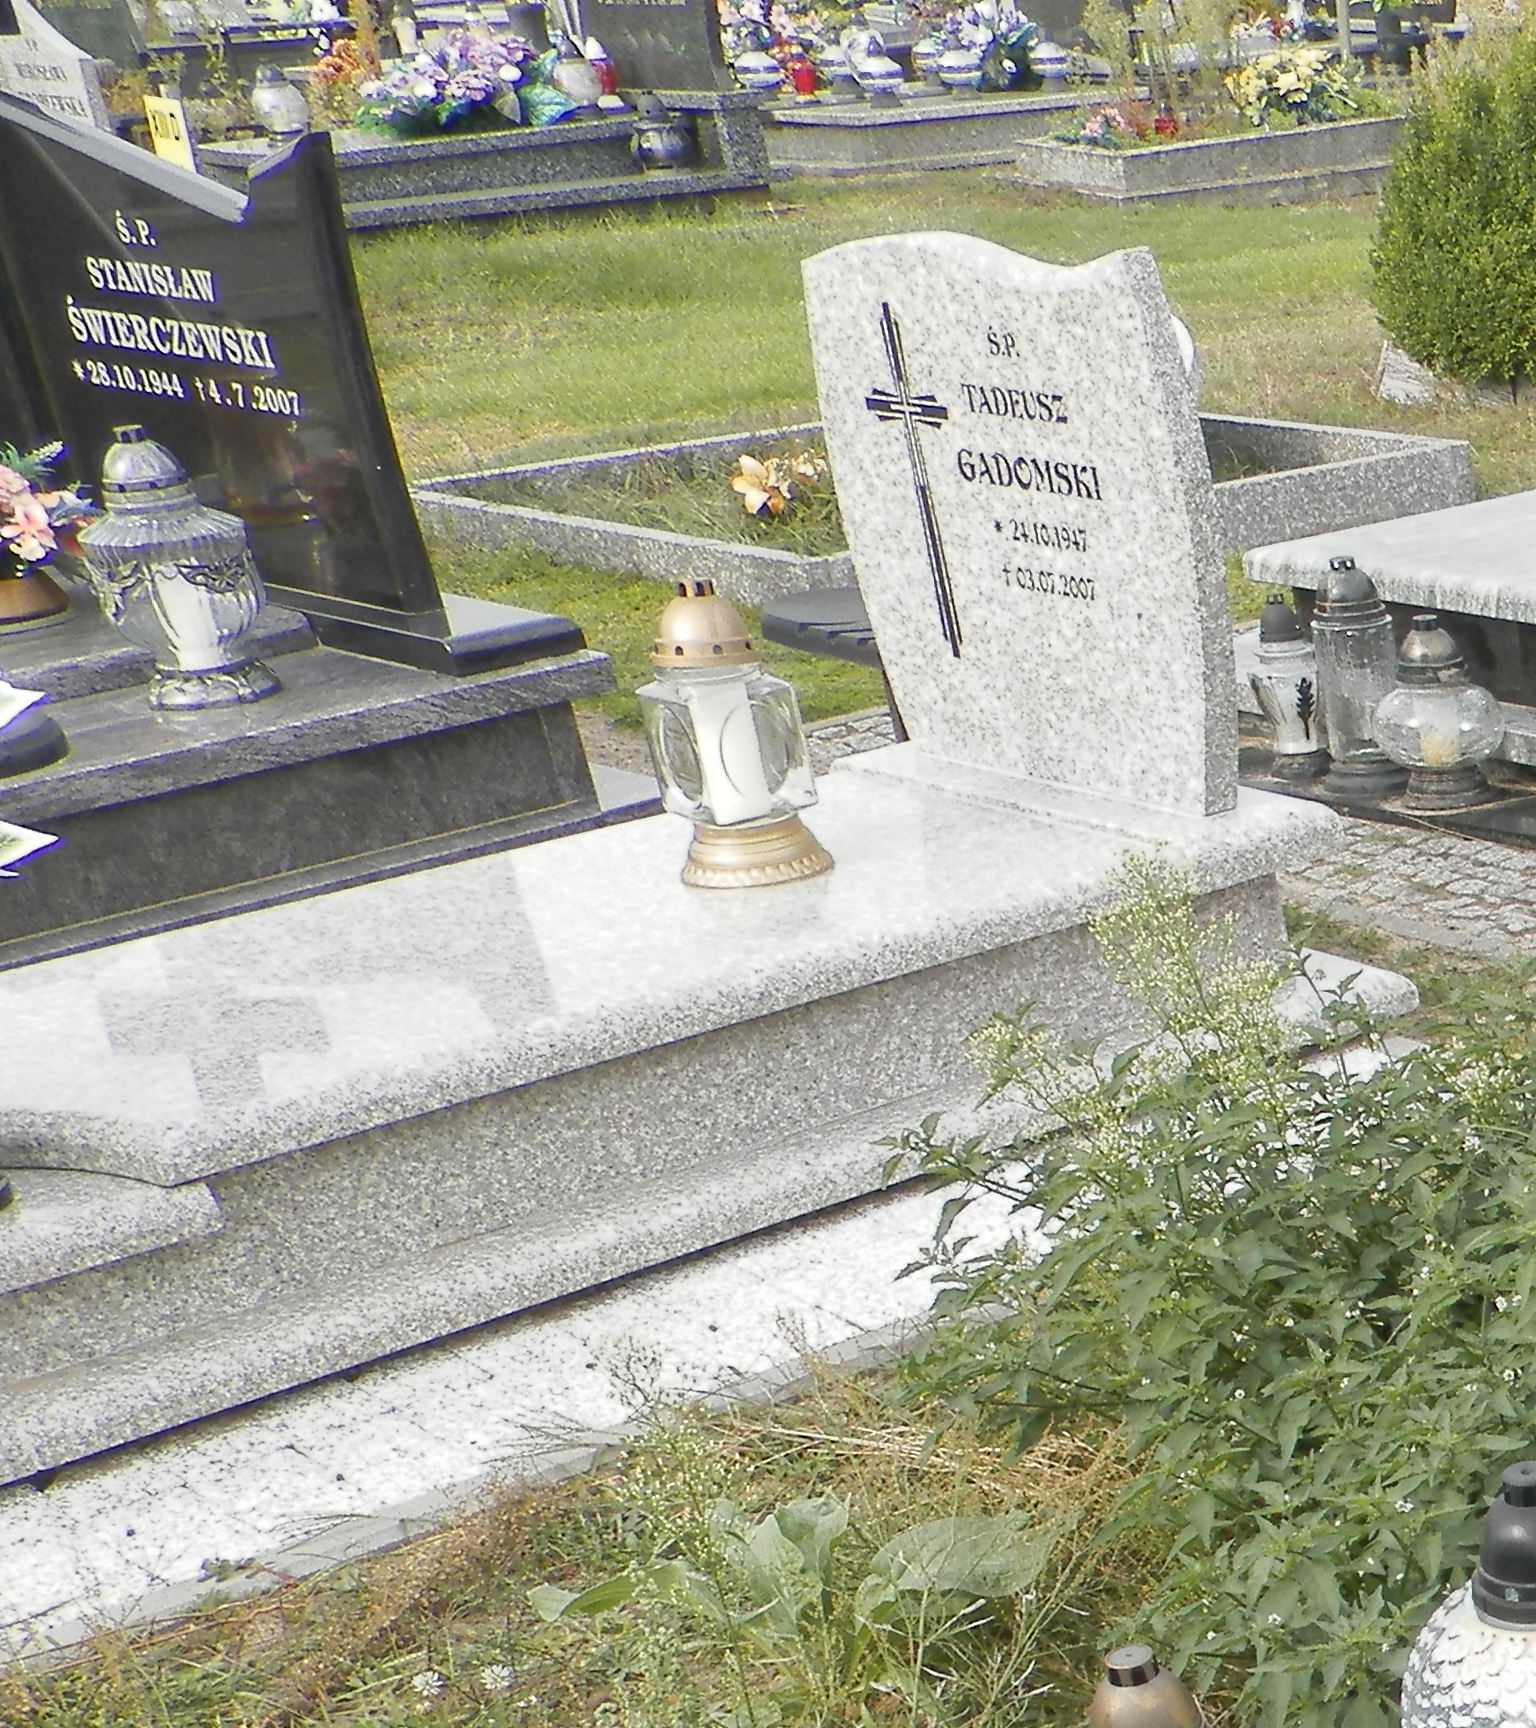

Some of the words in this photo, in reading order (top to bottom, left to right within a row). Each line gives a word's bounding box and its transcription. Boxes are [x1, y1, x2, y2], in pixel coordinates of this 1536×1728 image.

[86, 256, 215, 302] STANISŁAW
[66, 295, 275, 369] ŚWIERCZEWSKI
[960, 383, 1068, 424] TADEUSZ
[957, 449, 1102, 500] GADOMSKI
